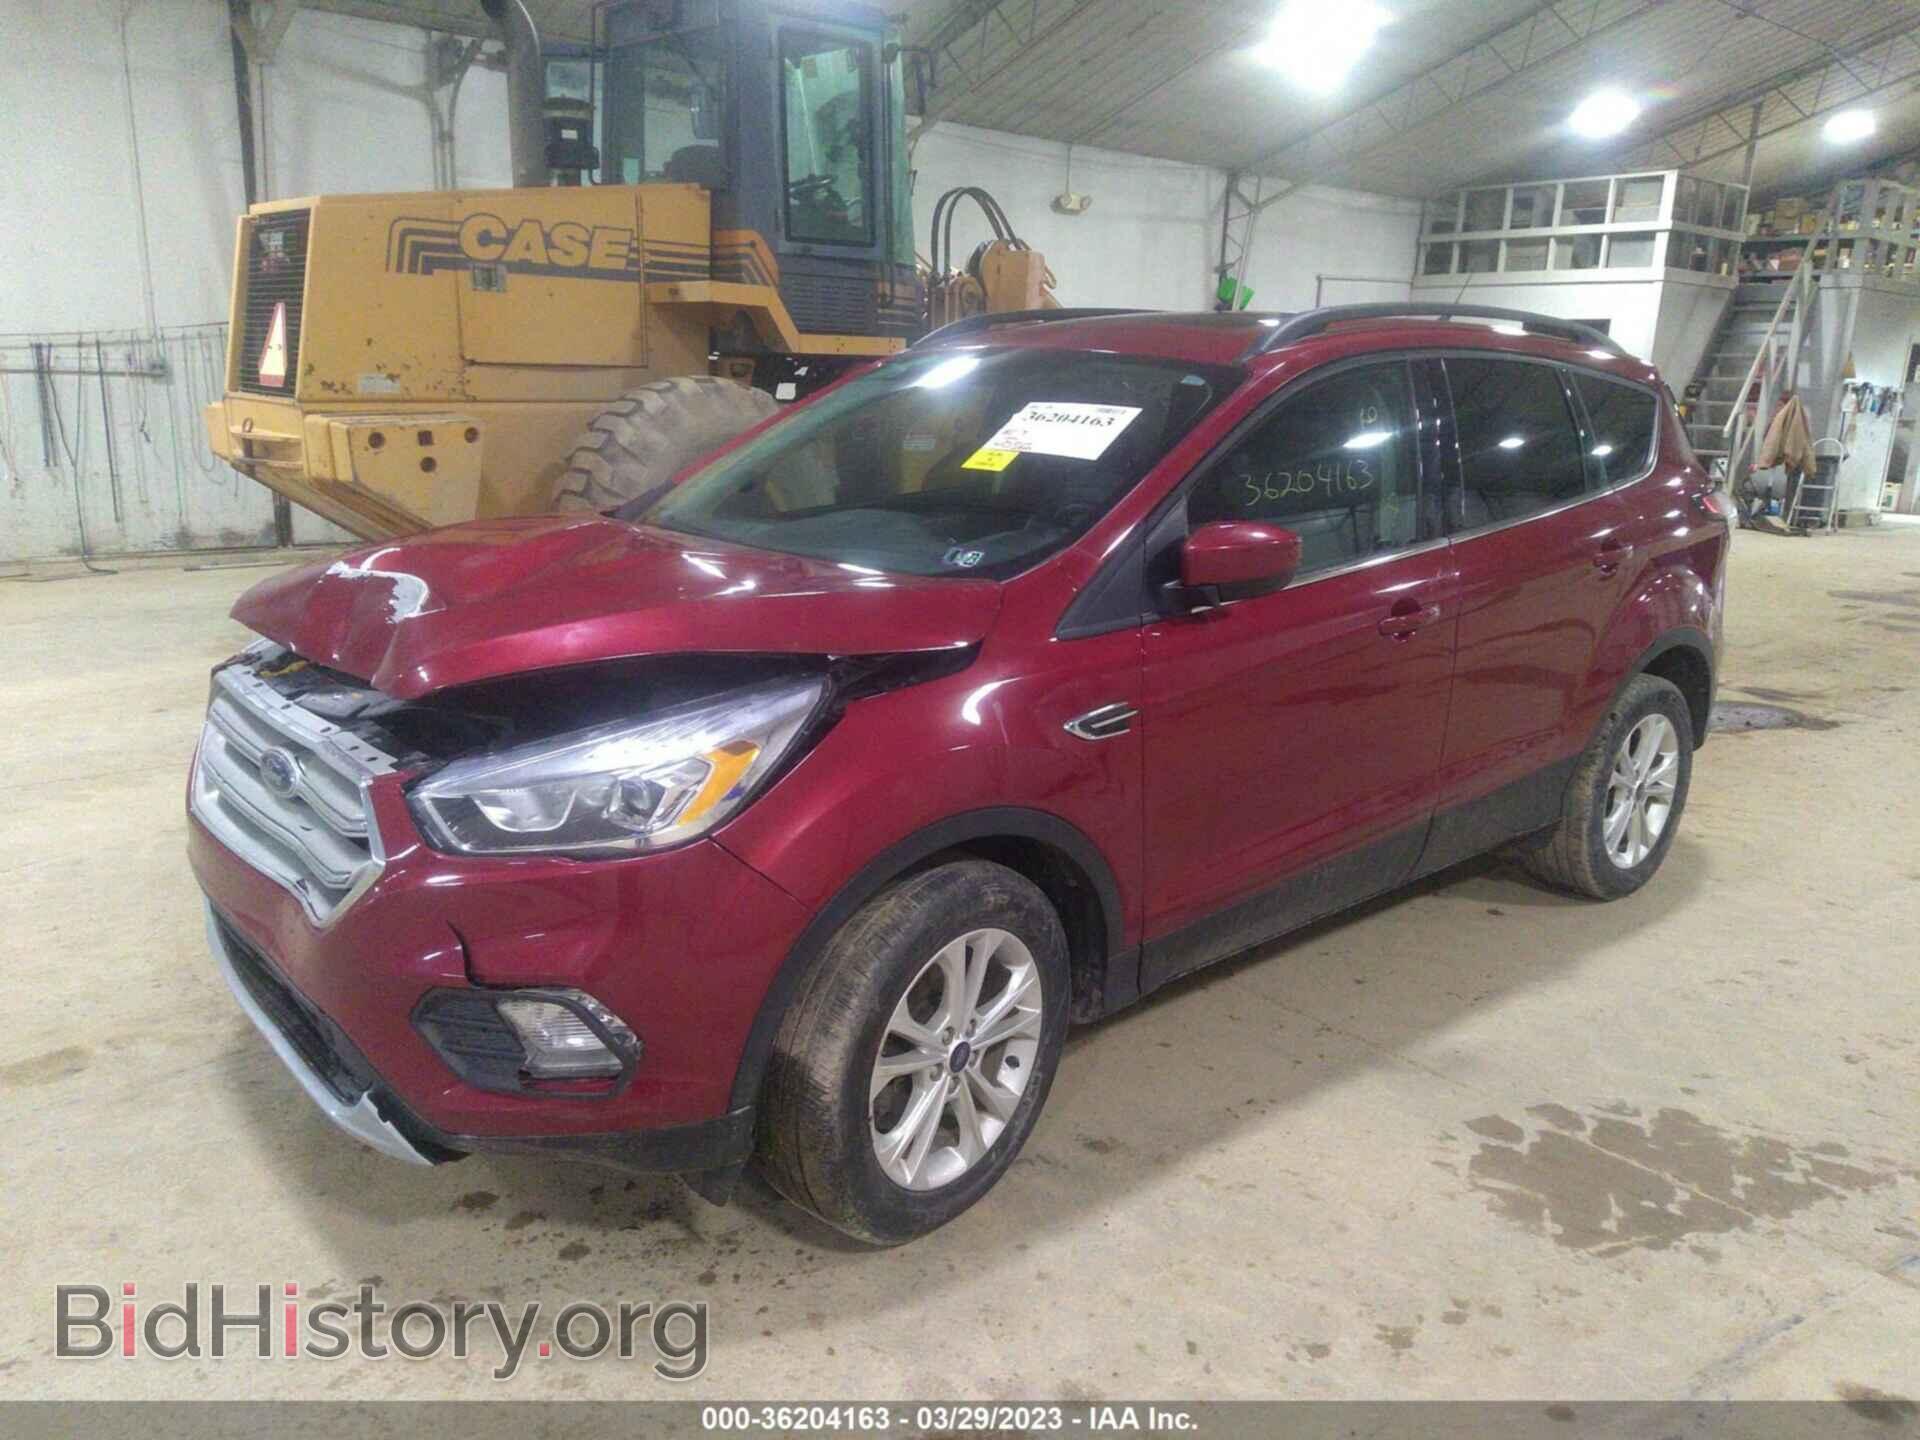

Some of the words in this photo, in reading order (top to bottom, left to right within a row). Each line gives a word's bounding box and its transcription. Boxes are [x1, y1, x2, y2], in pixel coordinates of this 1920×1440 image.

[459, 212, 634, 269] CASE
[1024, 411, 1115, 427] 36204163
[1240, 459, 1375, 506] 36204163
